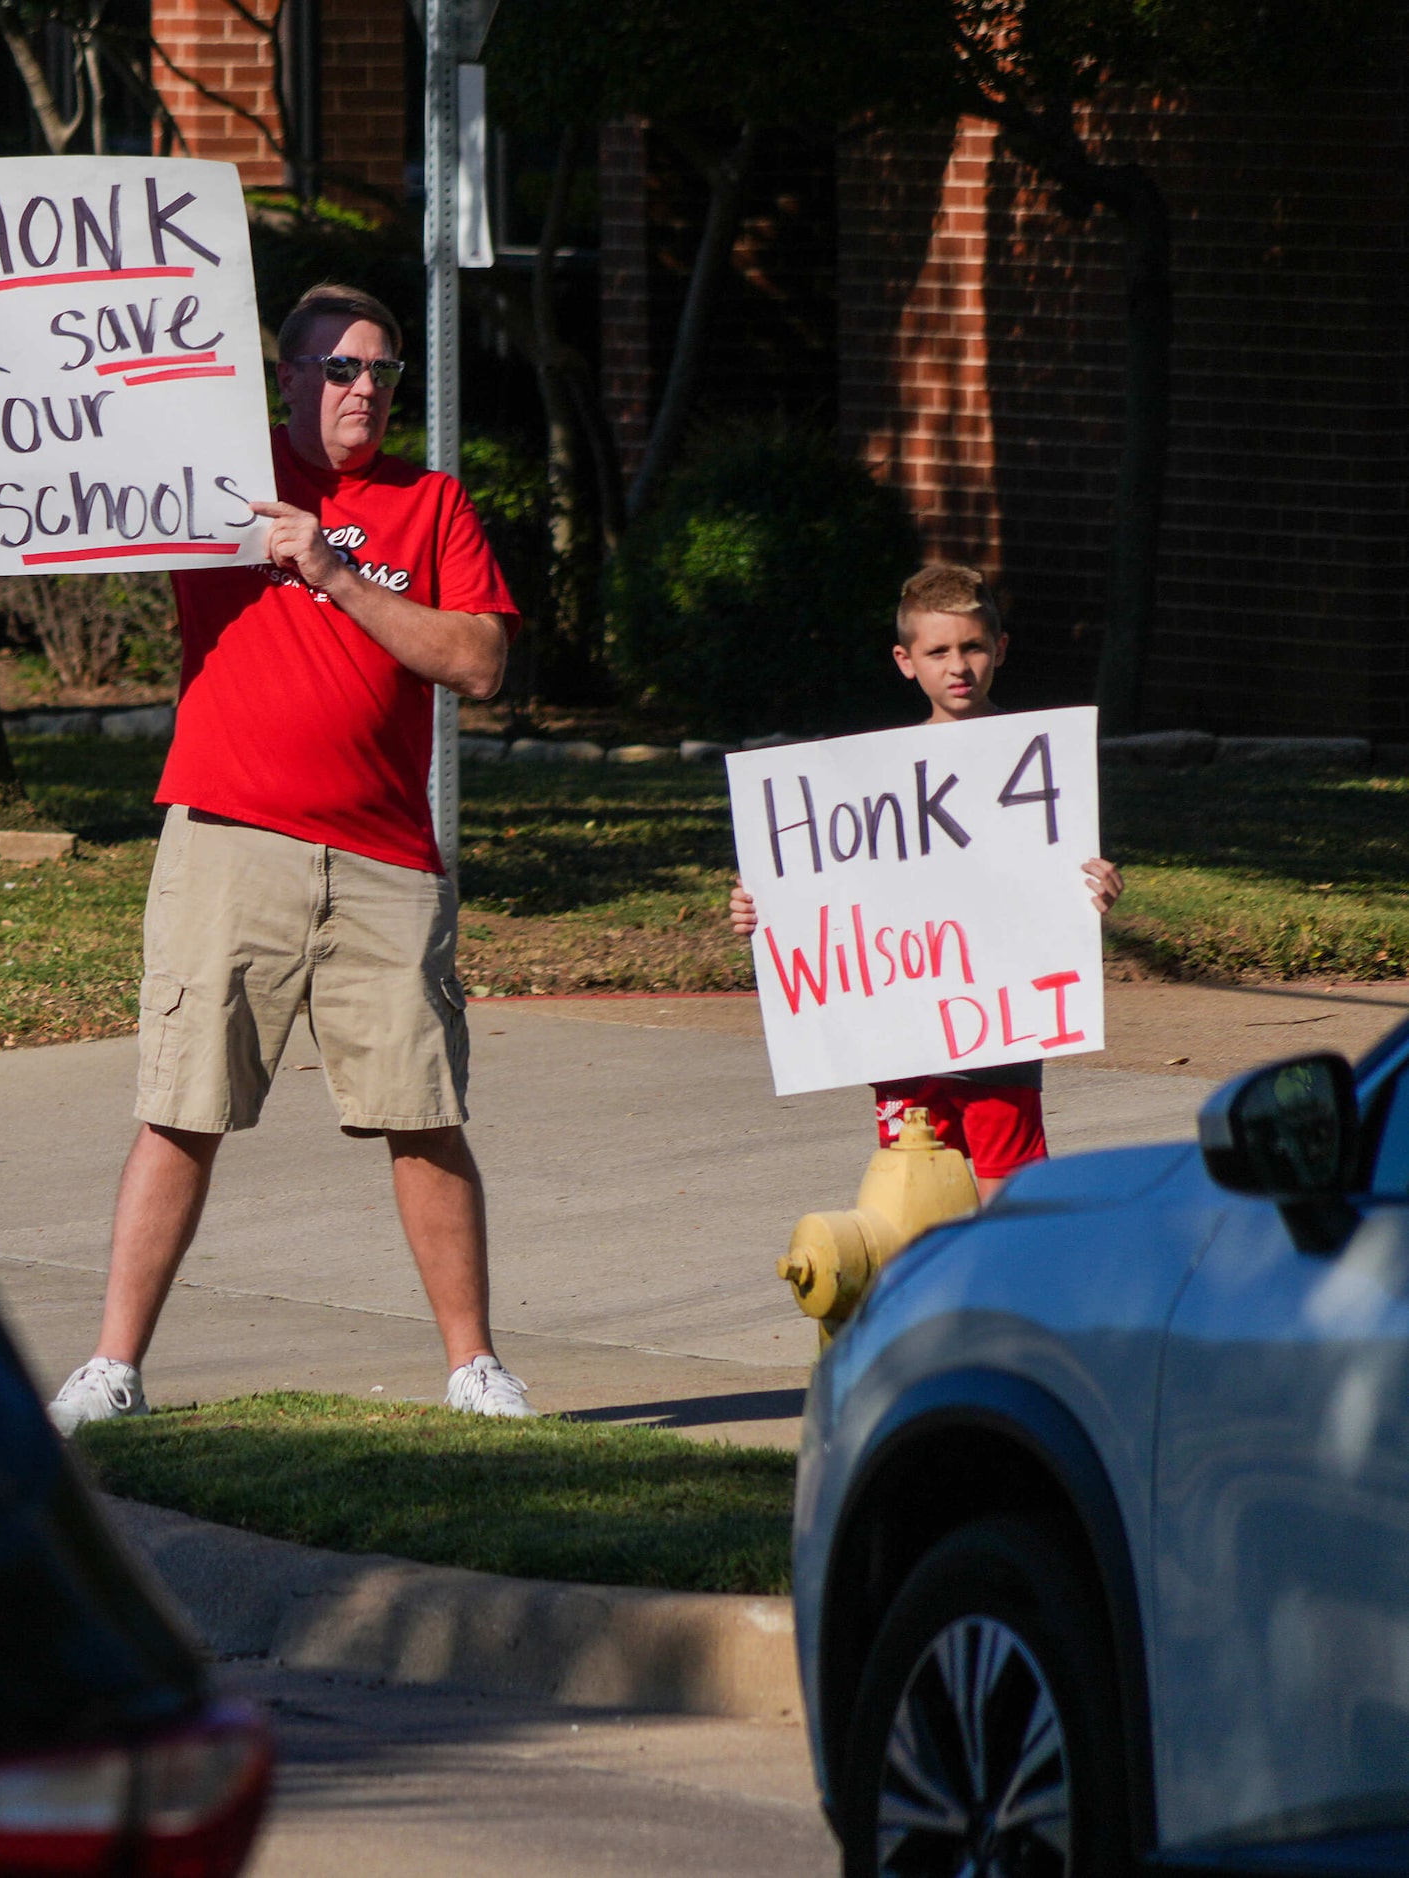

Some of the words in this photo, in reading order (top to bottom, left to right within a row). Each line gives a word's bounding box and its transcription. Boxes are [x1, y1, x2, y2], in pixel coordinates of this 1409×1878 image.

[1, 390, 115, 453] our
[321, 525, 367, 550] er
[763, 759, 972, 878] Honk
[997, 732, 1060, 846] 4
[764, 903, 976, 1016] Wilson
[937, 969, 1086, 1060] DLI
